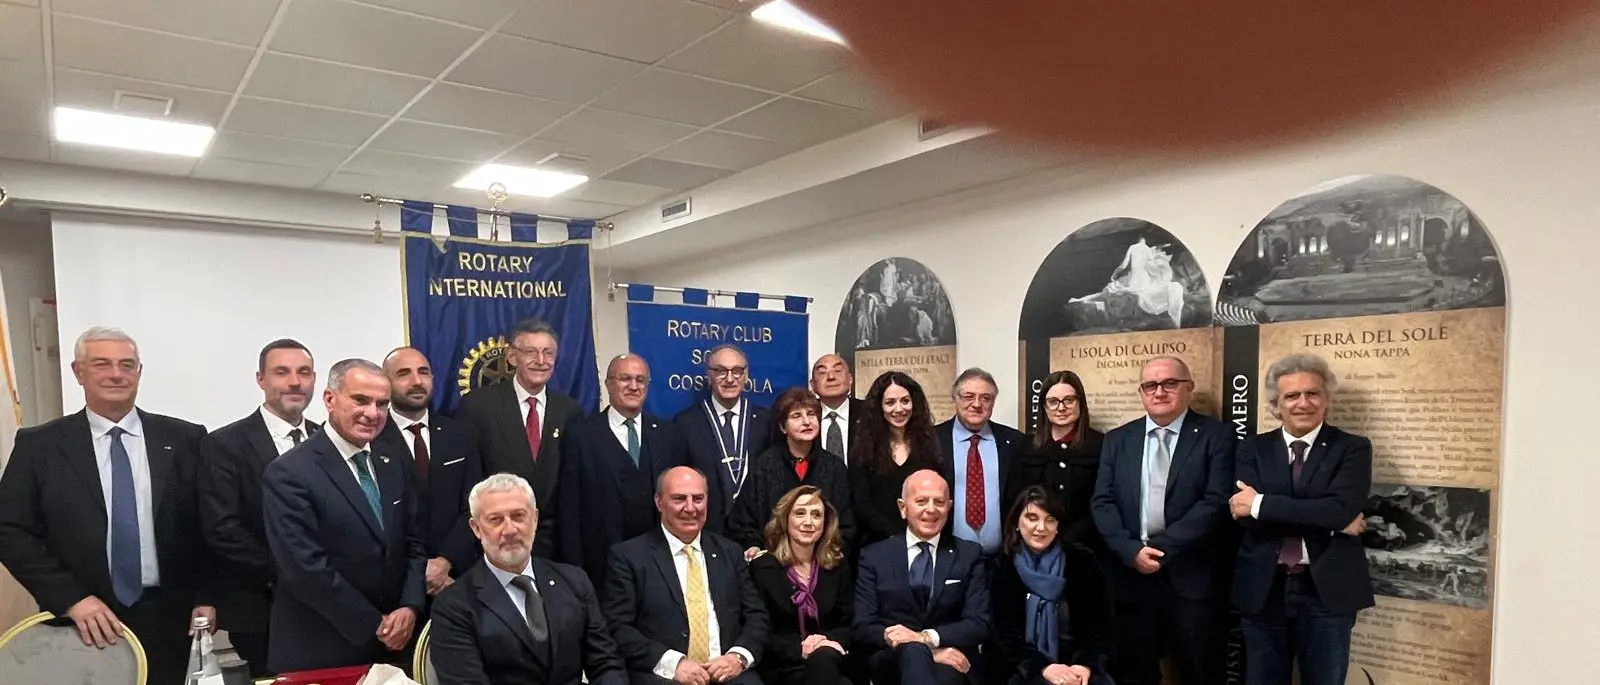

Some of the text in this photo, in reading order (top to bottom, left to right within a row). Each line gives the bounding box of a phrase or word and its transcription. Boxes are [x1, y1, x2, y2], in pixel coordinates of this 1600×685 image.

[458, 251, 534, 274] ROTARY
[429, 277, 567, 299] NTERNATIONAL
[667, 319, 773, 343] ROTARY CLUB
[1303, 325, 1449, 347] TERRA DEL SOLE
[885, 355, 909, 367] TERRA
[1071, 341, 1187, 359] L'ISOLA DI CALIPSO
[1334, 347, 1411, 360] NONA TAPPA
[1232, 374, 1249, 440] MERO
